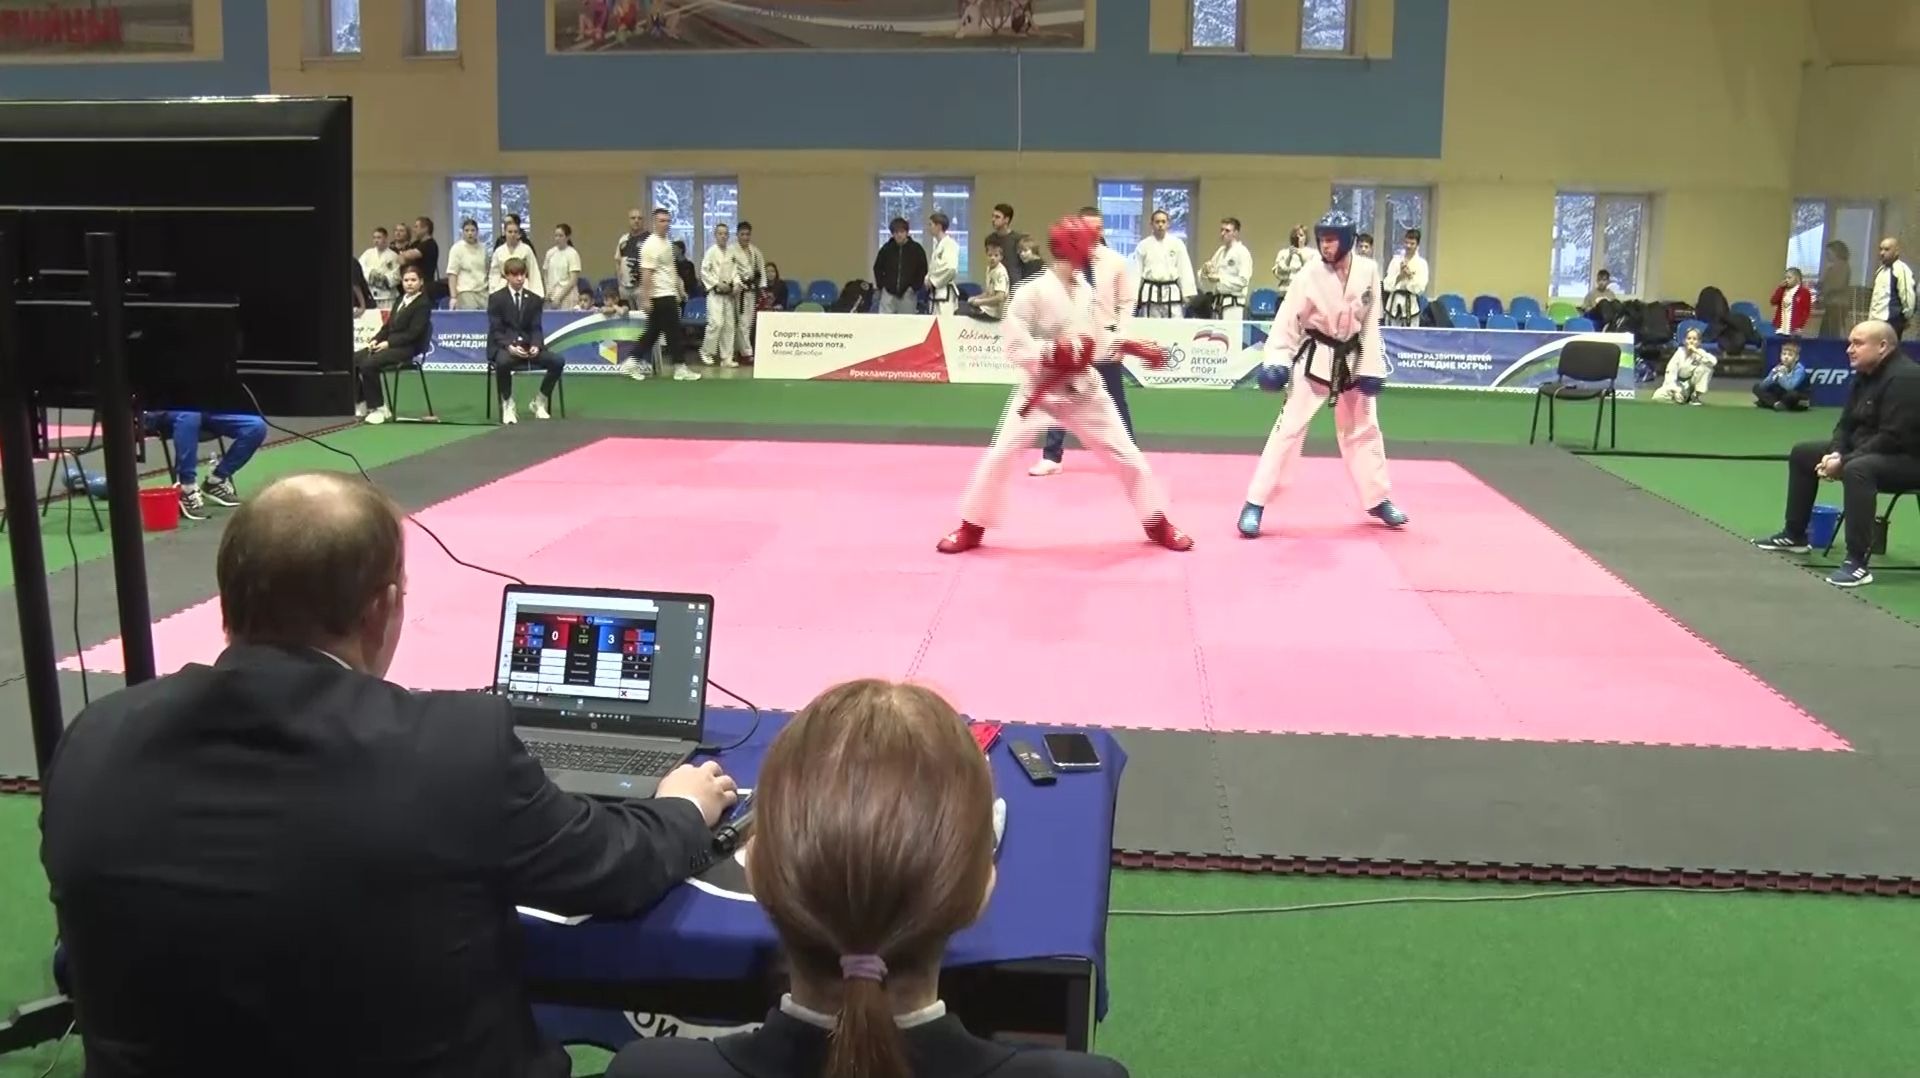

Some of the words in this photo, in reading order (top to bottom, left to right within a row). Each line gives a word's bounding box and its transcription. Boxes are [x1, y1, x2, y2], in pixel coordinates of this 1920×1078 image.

[438, 333, 461, 342] ЦЕНТР
[773, 330, 800, 339] Спорт:
[801, 332, 854, 340] развлечение
[785, 341, 824, 349] седьмого
[1190, 356, 1228, 365] ДЕТСКИЙ
[1424, 352, 1466, 361] РАЗВИТИЯ
[1466, 353, 1492, 362] ДЕТЕЙ
[551, 630, 559, 641] 0
[607, 634, 615, 644] 3
